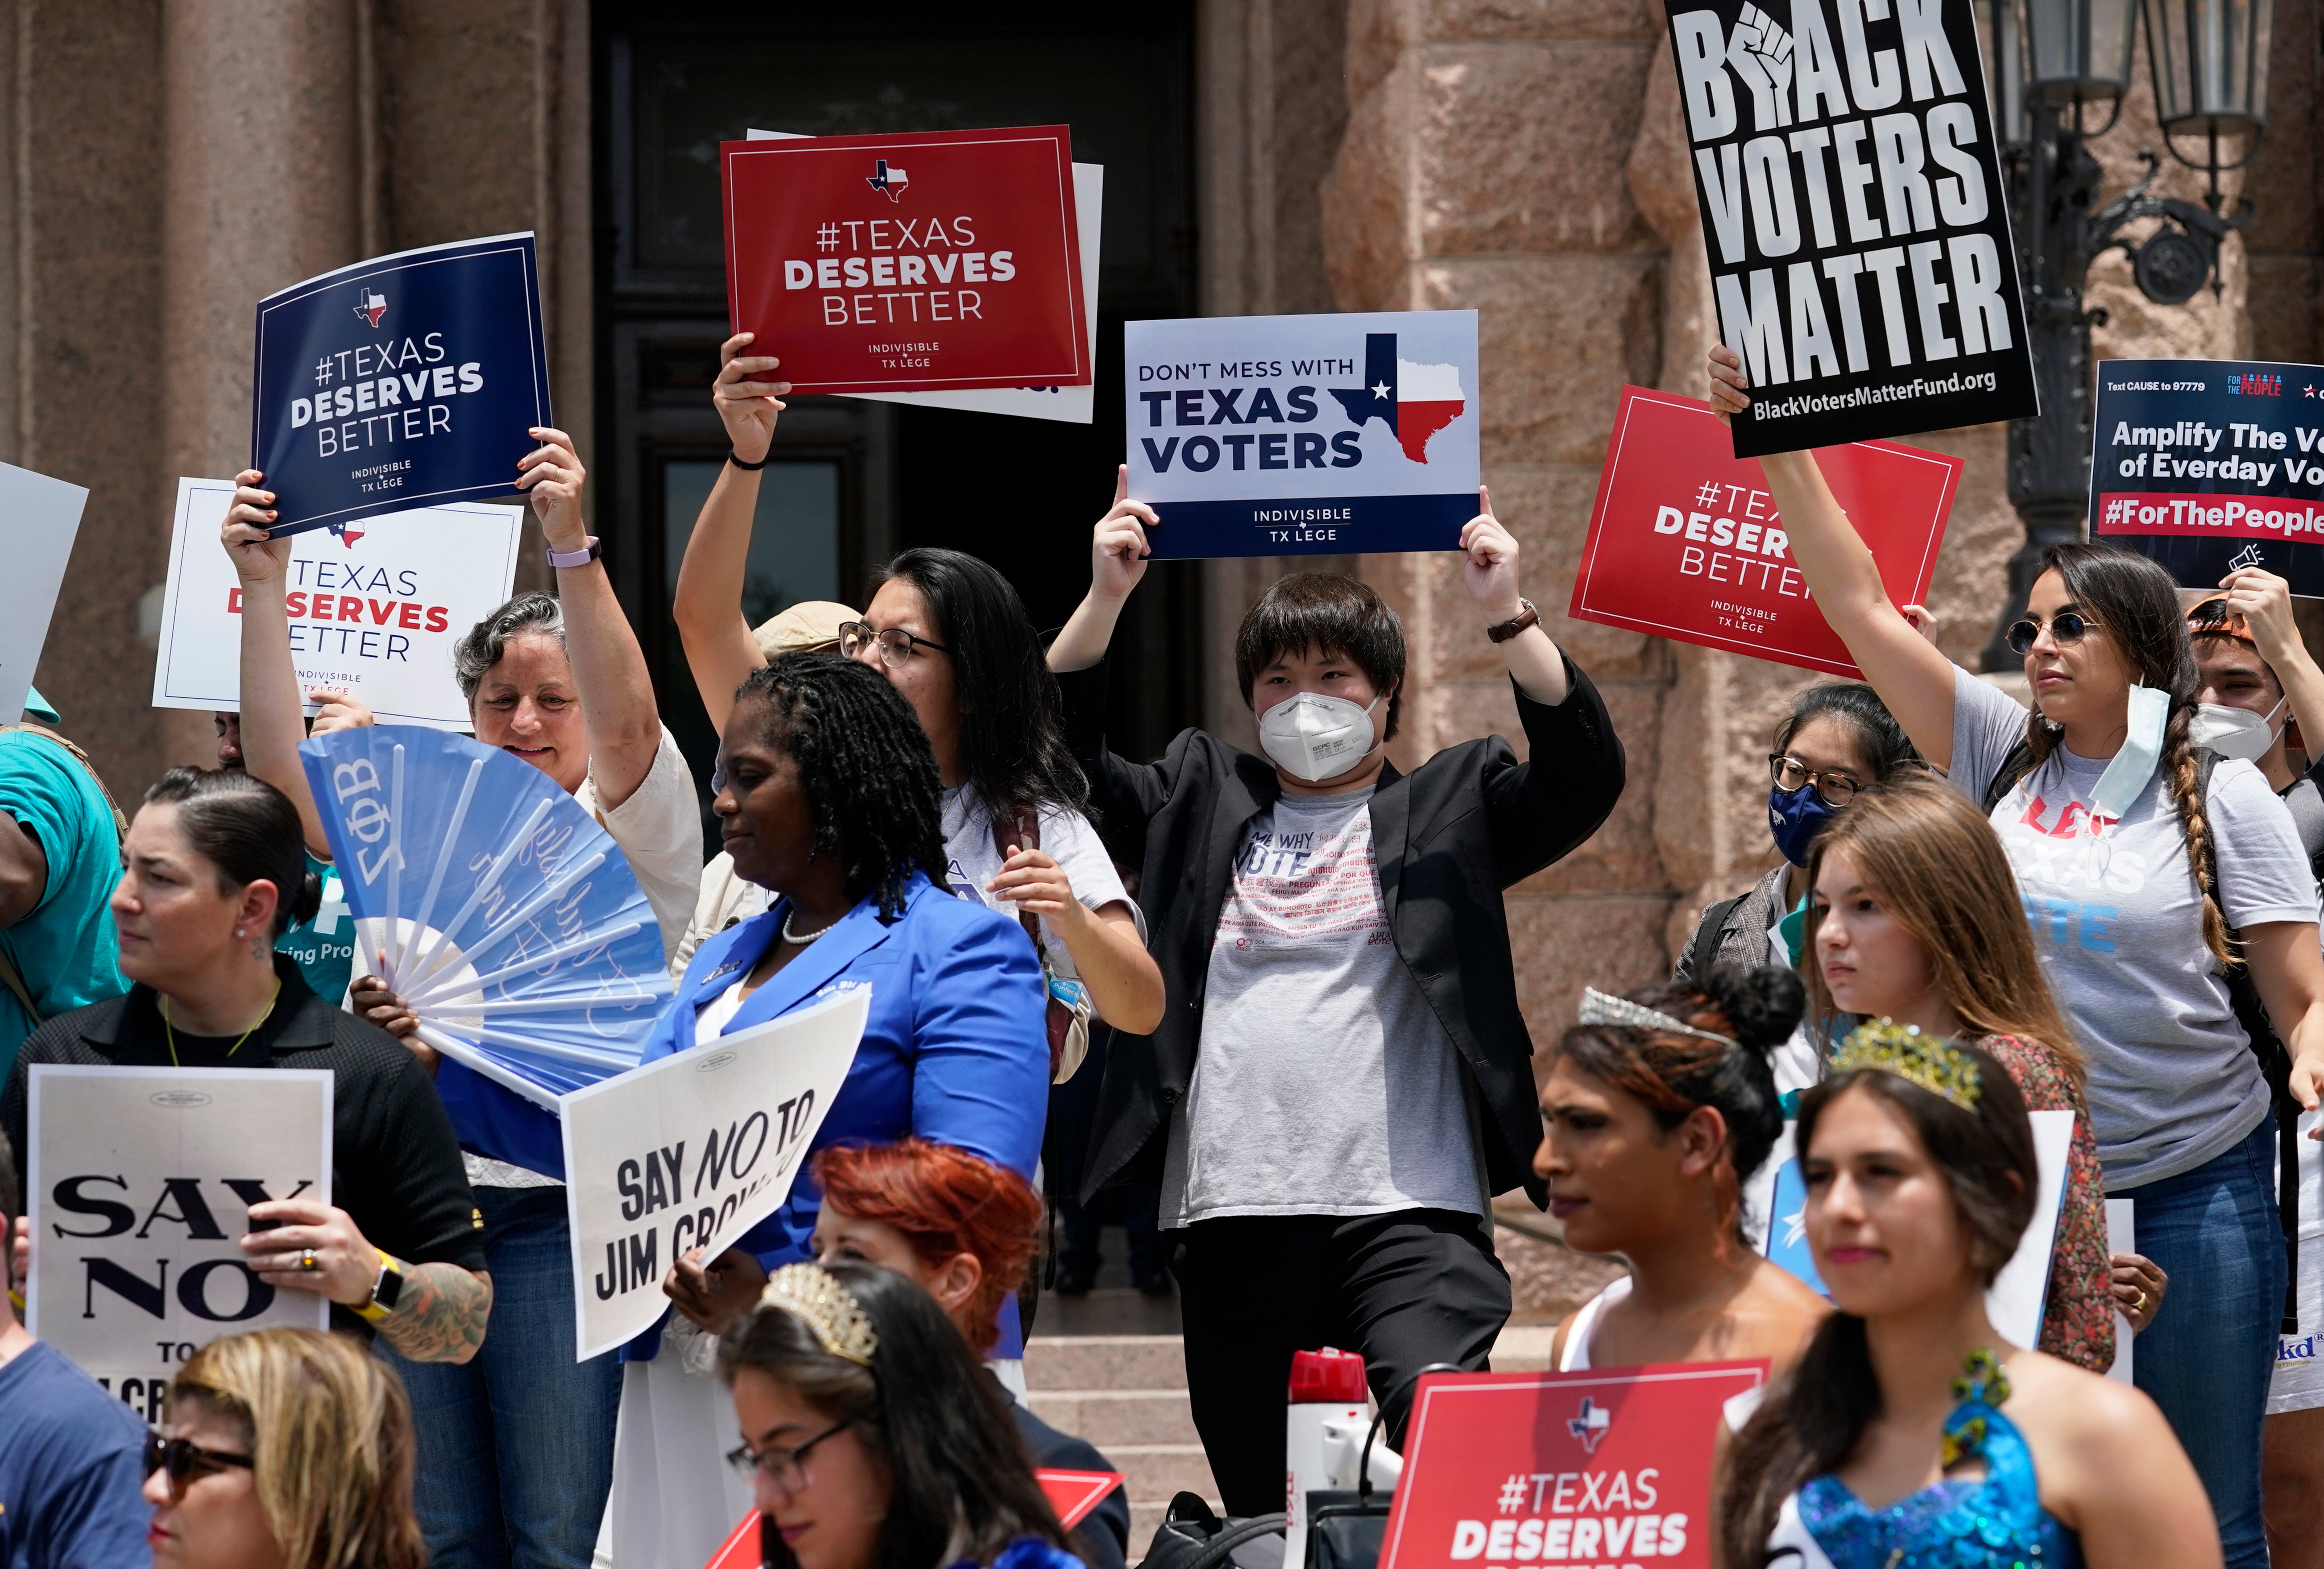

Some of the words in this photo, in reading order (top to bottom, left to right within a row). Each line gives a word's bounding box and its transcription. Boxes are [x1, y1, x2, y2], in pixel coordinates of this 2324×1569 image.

[1673, 0, 1967, 142] BACK
[1695, 102, 1988, 265] VOTERS
[816, 216, 975, 252] #TEXAS
[784, 251, 1016, 290] DESERVES
[823, 290, 983, 326] BETTER
[1715, 233, 2013, 389] MATTER
[315, 332, 445, 387] #TEXAS
[868, 342, 940, 353] INDIVISIBLE
[882, 360, 896, 368] TX
[900, 358, 931, 368] LEGE
[1139, 363, 1212, 381] DON'T
[1221, 360, 1283, 379] MESS
[1291, 359, 1354, 377] WITH
[2108, 382, 2125, 391] Text
[2127, 381, 2159, 391] CAUSE
[2161, 382, 2171, 391] to
[2172, 382, 2205, 392] 97779
[2228, 375, 2241, 385] FOR
[291, 362, 484, 429] DESERVES
[1139, 385, 1318, 427] TEXAS
[1753, 372, 1997, 421] BlackVotersMatterFund.org
[2227, 385, 2241, 395] THE
[2240, 381, 2282, 397] PEOPLE
[318, 404, 452, 458] BETTER
[2112, 421, 2222, 452] Amplify
[2229, 423, 2287, 450] The
[352, 460, 411, 480] INDIVISIBLE
[1140, 431, 1363, 473] VOTERS
[2119, 453, 2147, 477] of
[2152, 453, 2277, 487] Everday
[361, 483, 374, 493] TX
[377, 477, 403, 491] LEGE
[1254, 508, 1351, 522] INDIVISIBLE
[1653, 505, 1789, 559] DESER
[1270, 531, 1289, 542] TX
[1295, 529, 1337, 542] LEGE
[287, 559, 418, 596] TEXAS
[228, 588, 448, 633] DSERVES
[1710, 599, 1777, 621] INDIVISIBLE
[1718, 617, 1732, 627] TX
[1735, 619, 1765, 634] LEGE
[290, 625, 410, 662] ETTER
[1251, 831, 1273, 847] ME
[1280, 832, 1314, 849] WHY
[1234, 842, 1312, 878] VOTE
[1054, 983, 1074, 995] Purified
[617, 1140, 686, 1221] SAY
[694, 1110, 769, 1199] NO
[776, 1089, 815, 1157] TO
[52, 1174, 314, 1240] SAY
[596, 1227, 657, 1301] JIM
[80, 1257, 275, 1322] NO
[157, 1342, 198, 1363] TO
[1496, 1467, 1660, 1515] #TEXAS
[1450, 1512, 1688, 1561] DESERVES
